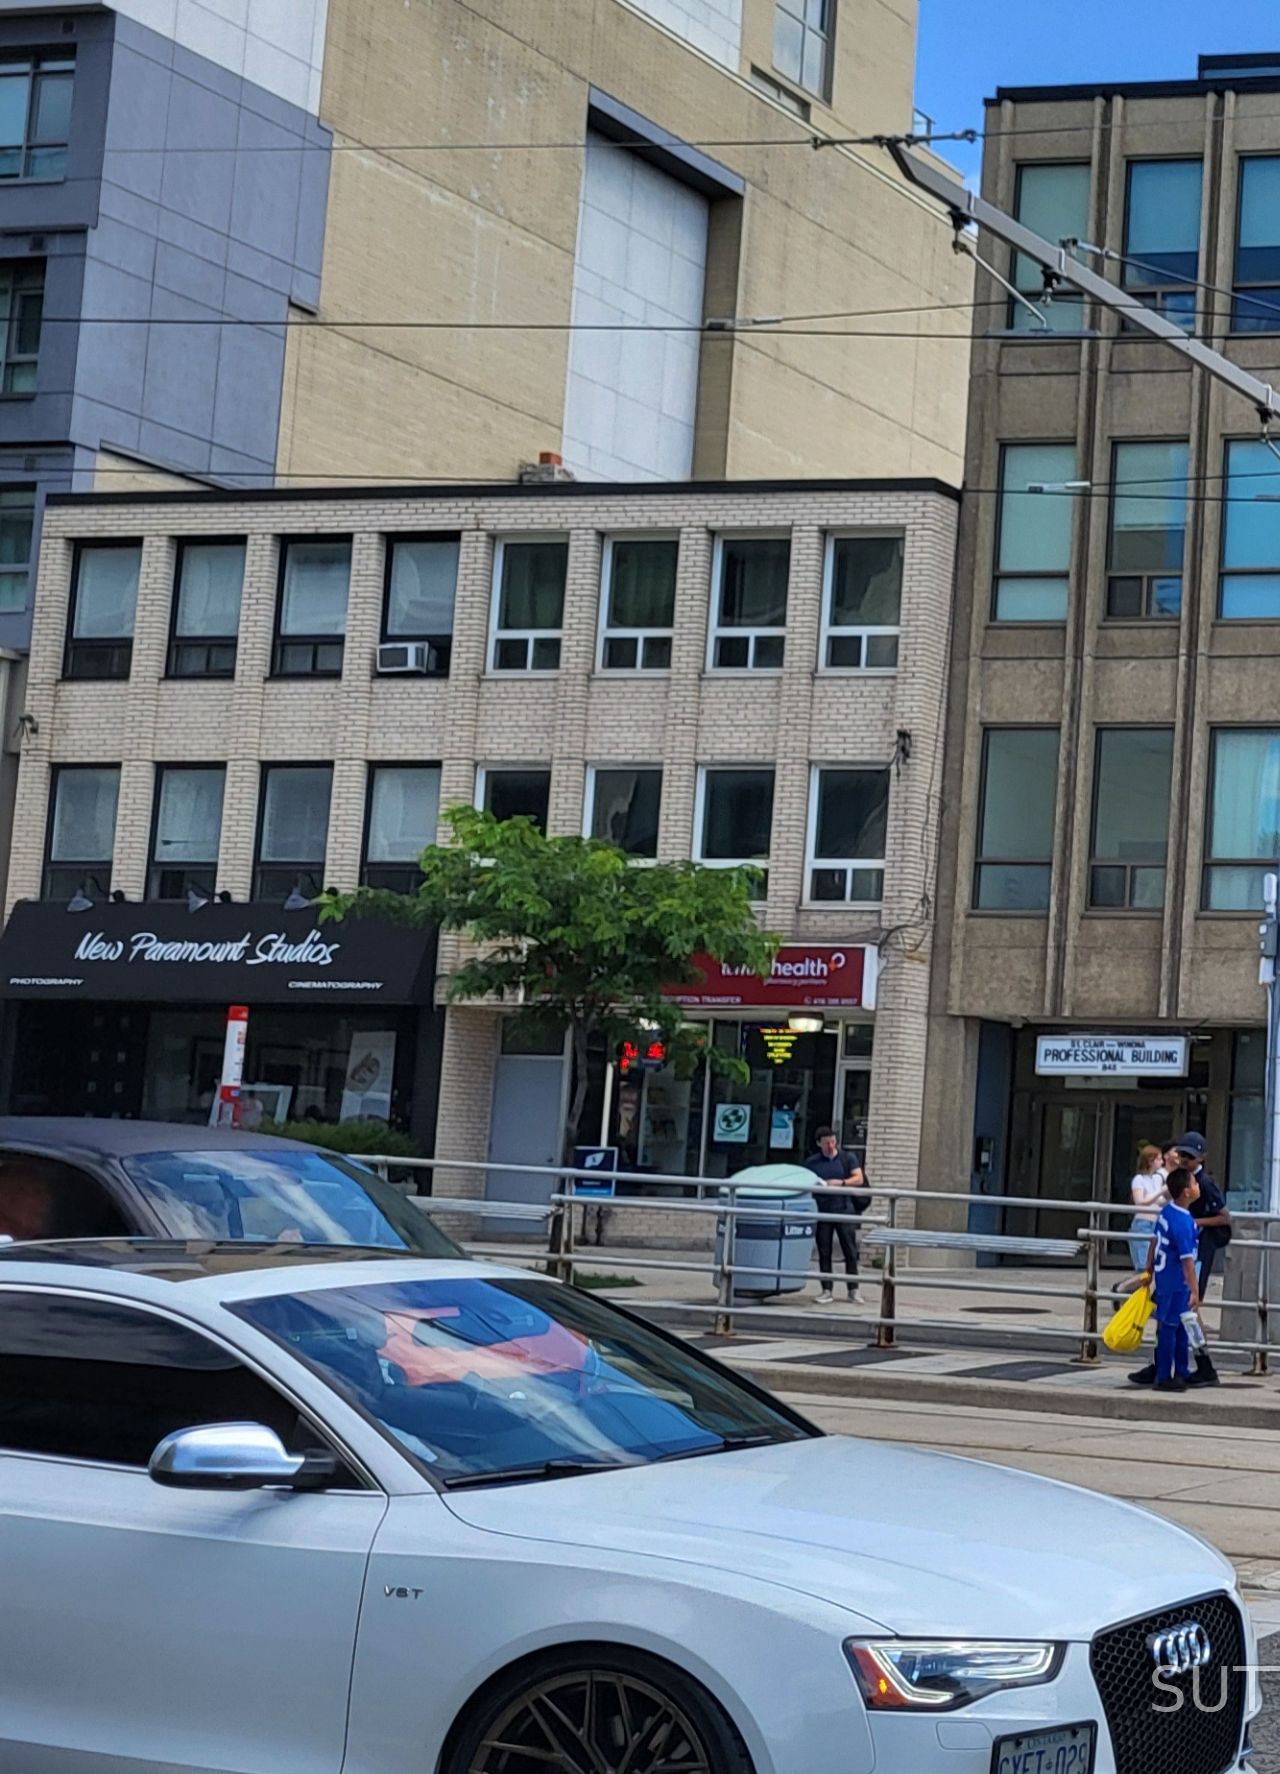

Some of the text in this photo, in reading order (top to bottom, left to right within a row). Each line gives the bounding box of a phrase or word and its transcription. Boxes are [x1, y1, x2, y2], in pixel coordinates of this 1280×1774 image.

[74, 928, 341, 965] New Paramount Studios
[9, 977, 85, 985] PHOTOGRAPHY
[287, 980, 384, 990] CINEMATOGRAPHY
[1043, 1047, 1178, 1064] PROFESSIONAL BUILDING
[784, 1224, 804, 1237] Litter
